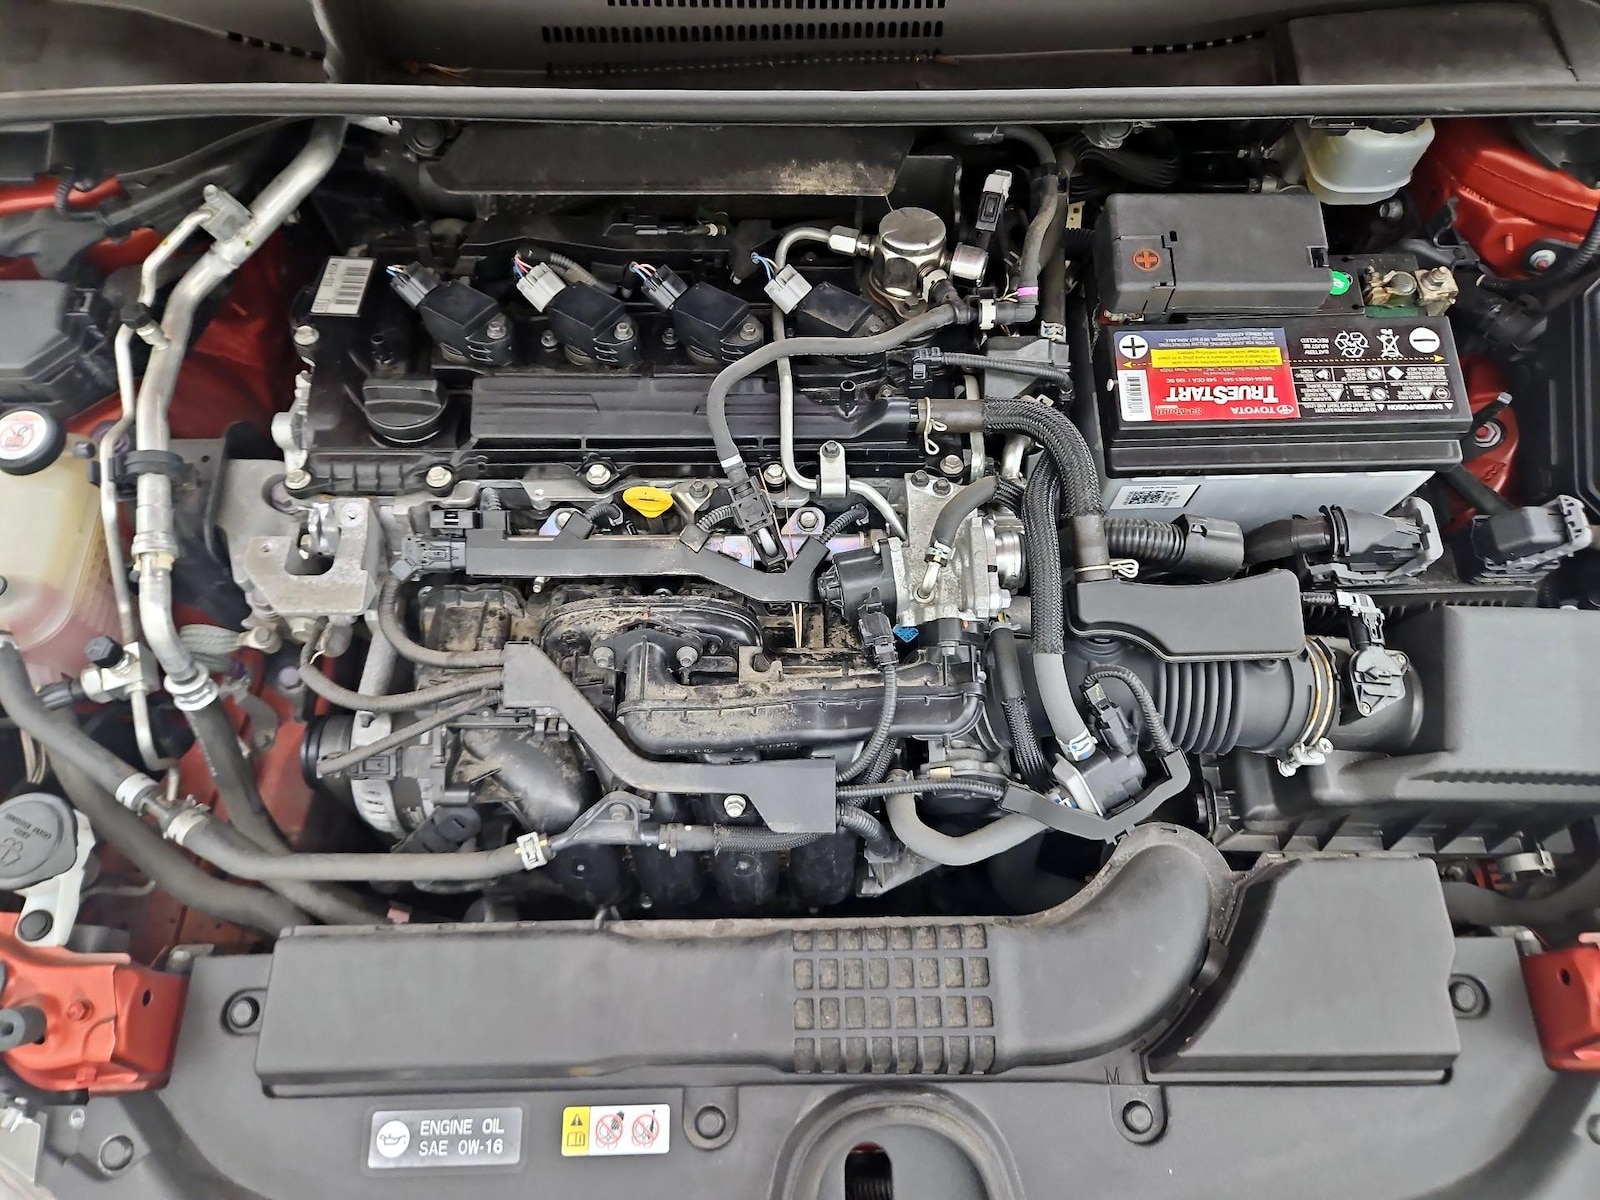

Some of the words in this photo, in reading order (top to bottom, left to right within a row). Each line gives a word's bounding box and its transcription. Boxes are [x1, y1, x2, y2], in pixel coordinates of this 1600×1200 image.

[1230, 406, 1276, 415] TOYOTA
[420, 1118, 472, 1135] ENGINE
[482, 1118, 504, 1134] OIL
[418, 1140, 448, 1156] SAE
[458, 1138, 504, 1156] 0W-16
